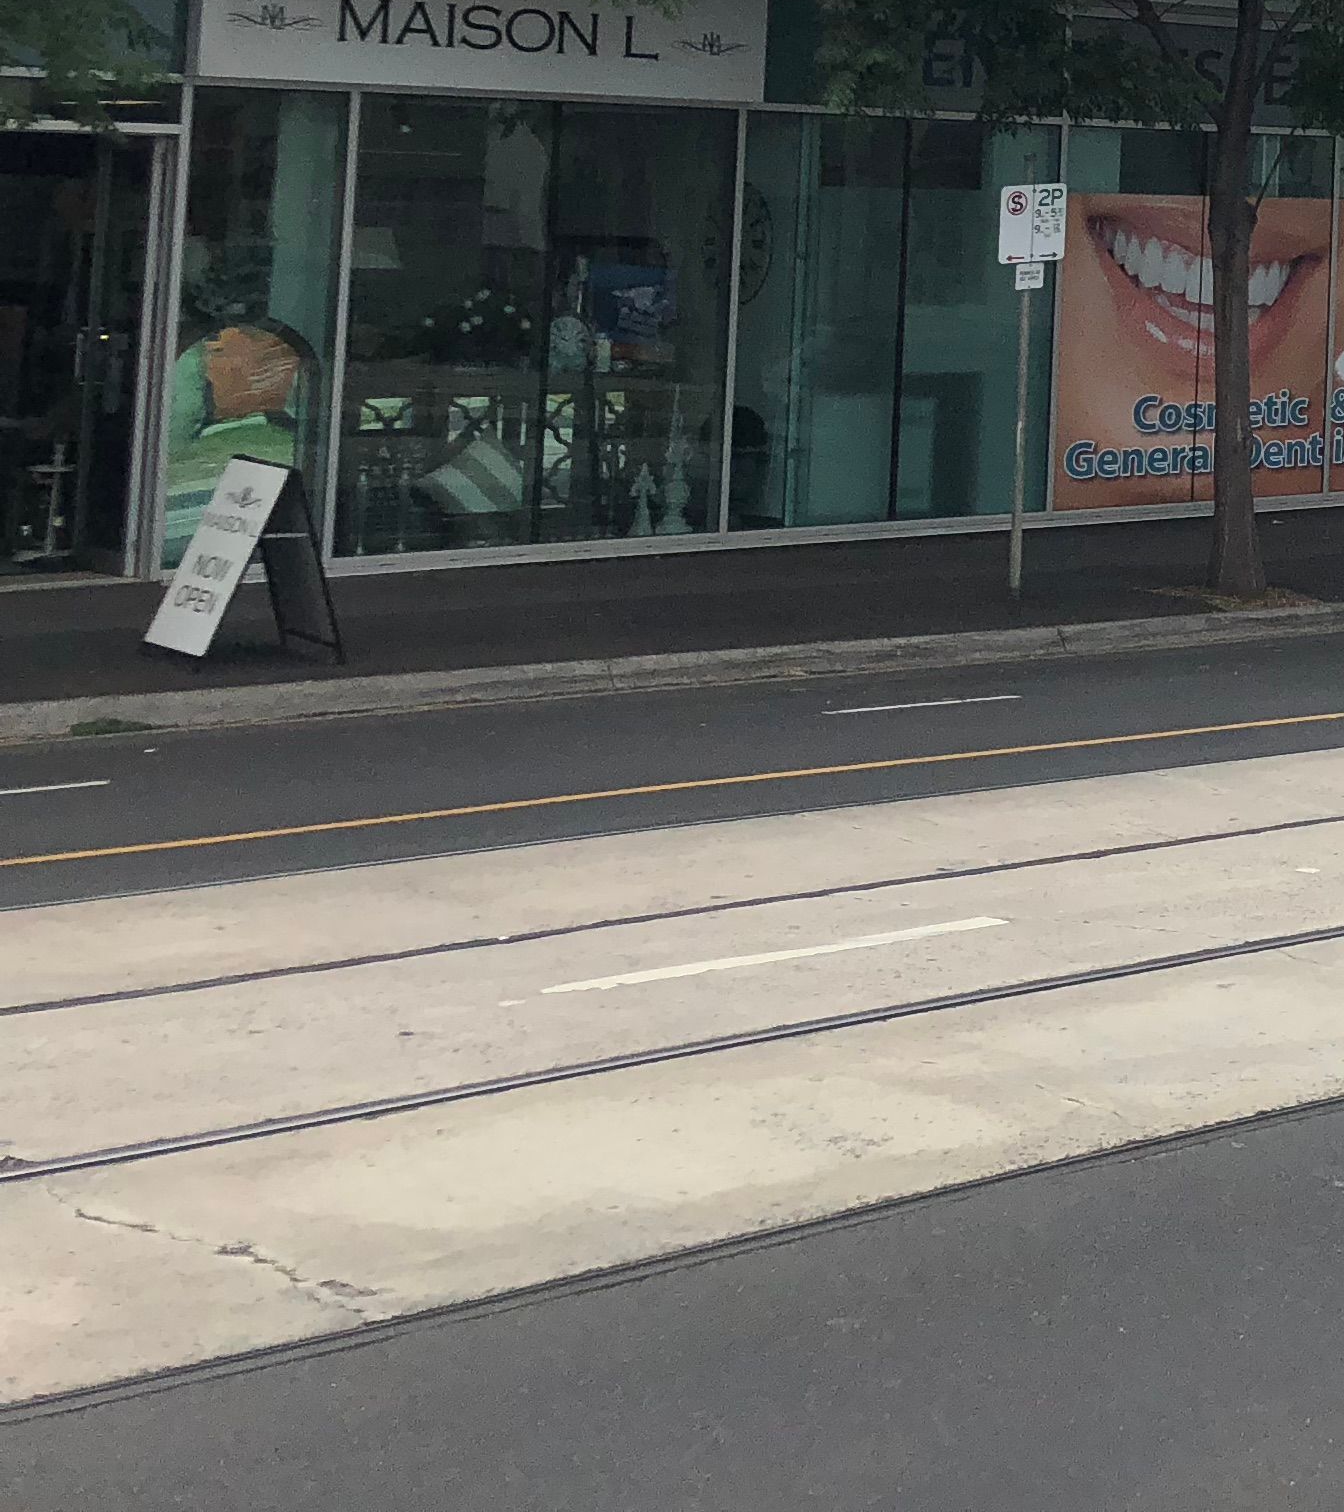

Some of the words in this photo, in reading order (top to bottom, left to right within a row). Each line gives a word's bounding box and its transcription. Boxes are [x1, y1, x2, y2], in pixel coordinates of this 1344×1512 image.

[623, 15, 659, 61] L
[1038, 188, 1064, 207] 2P
[1063, 433, 1216, 480] Genera
